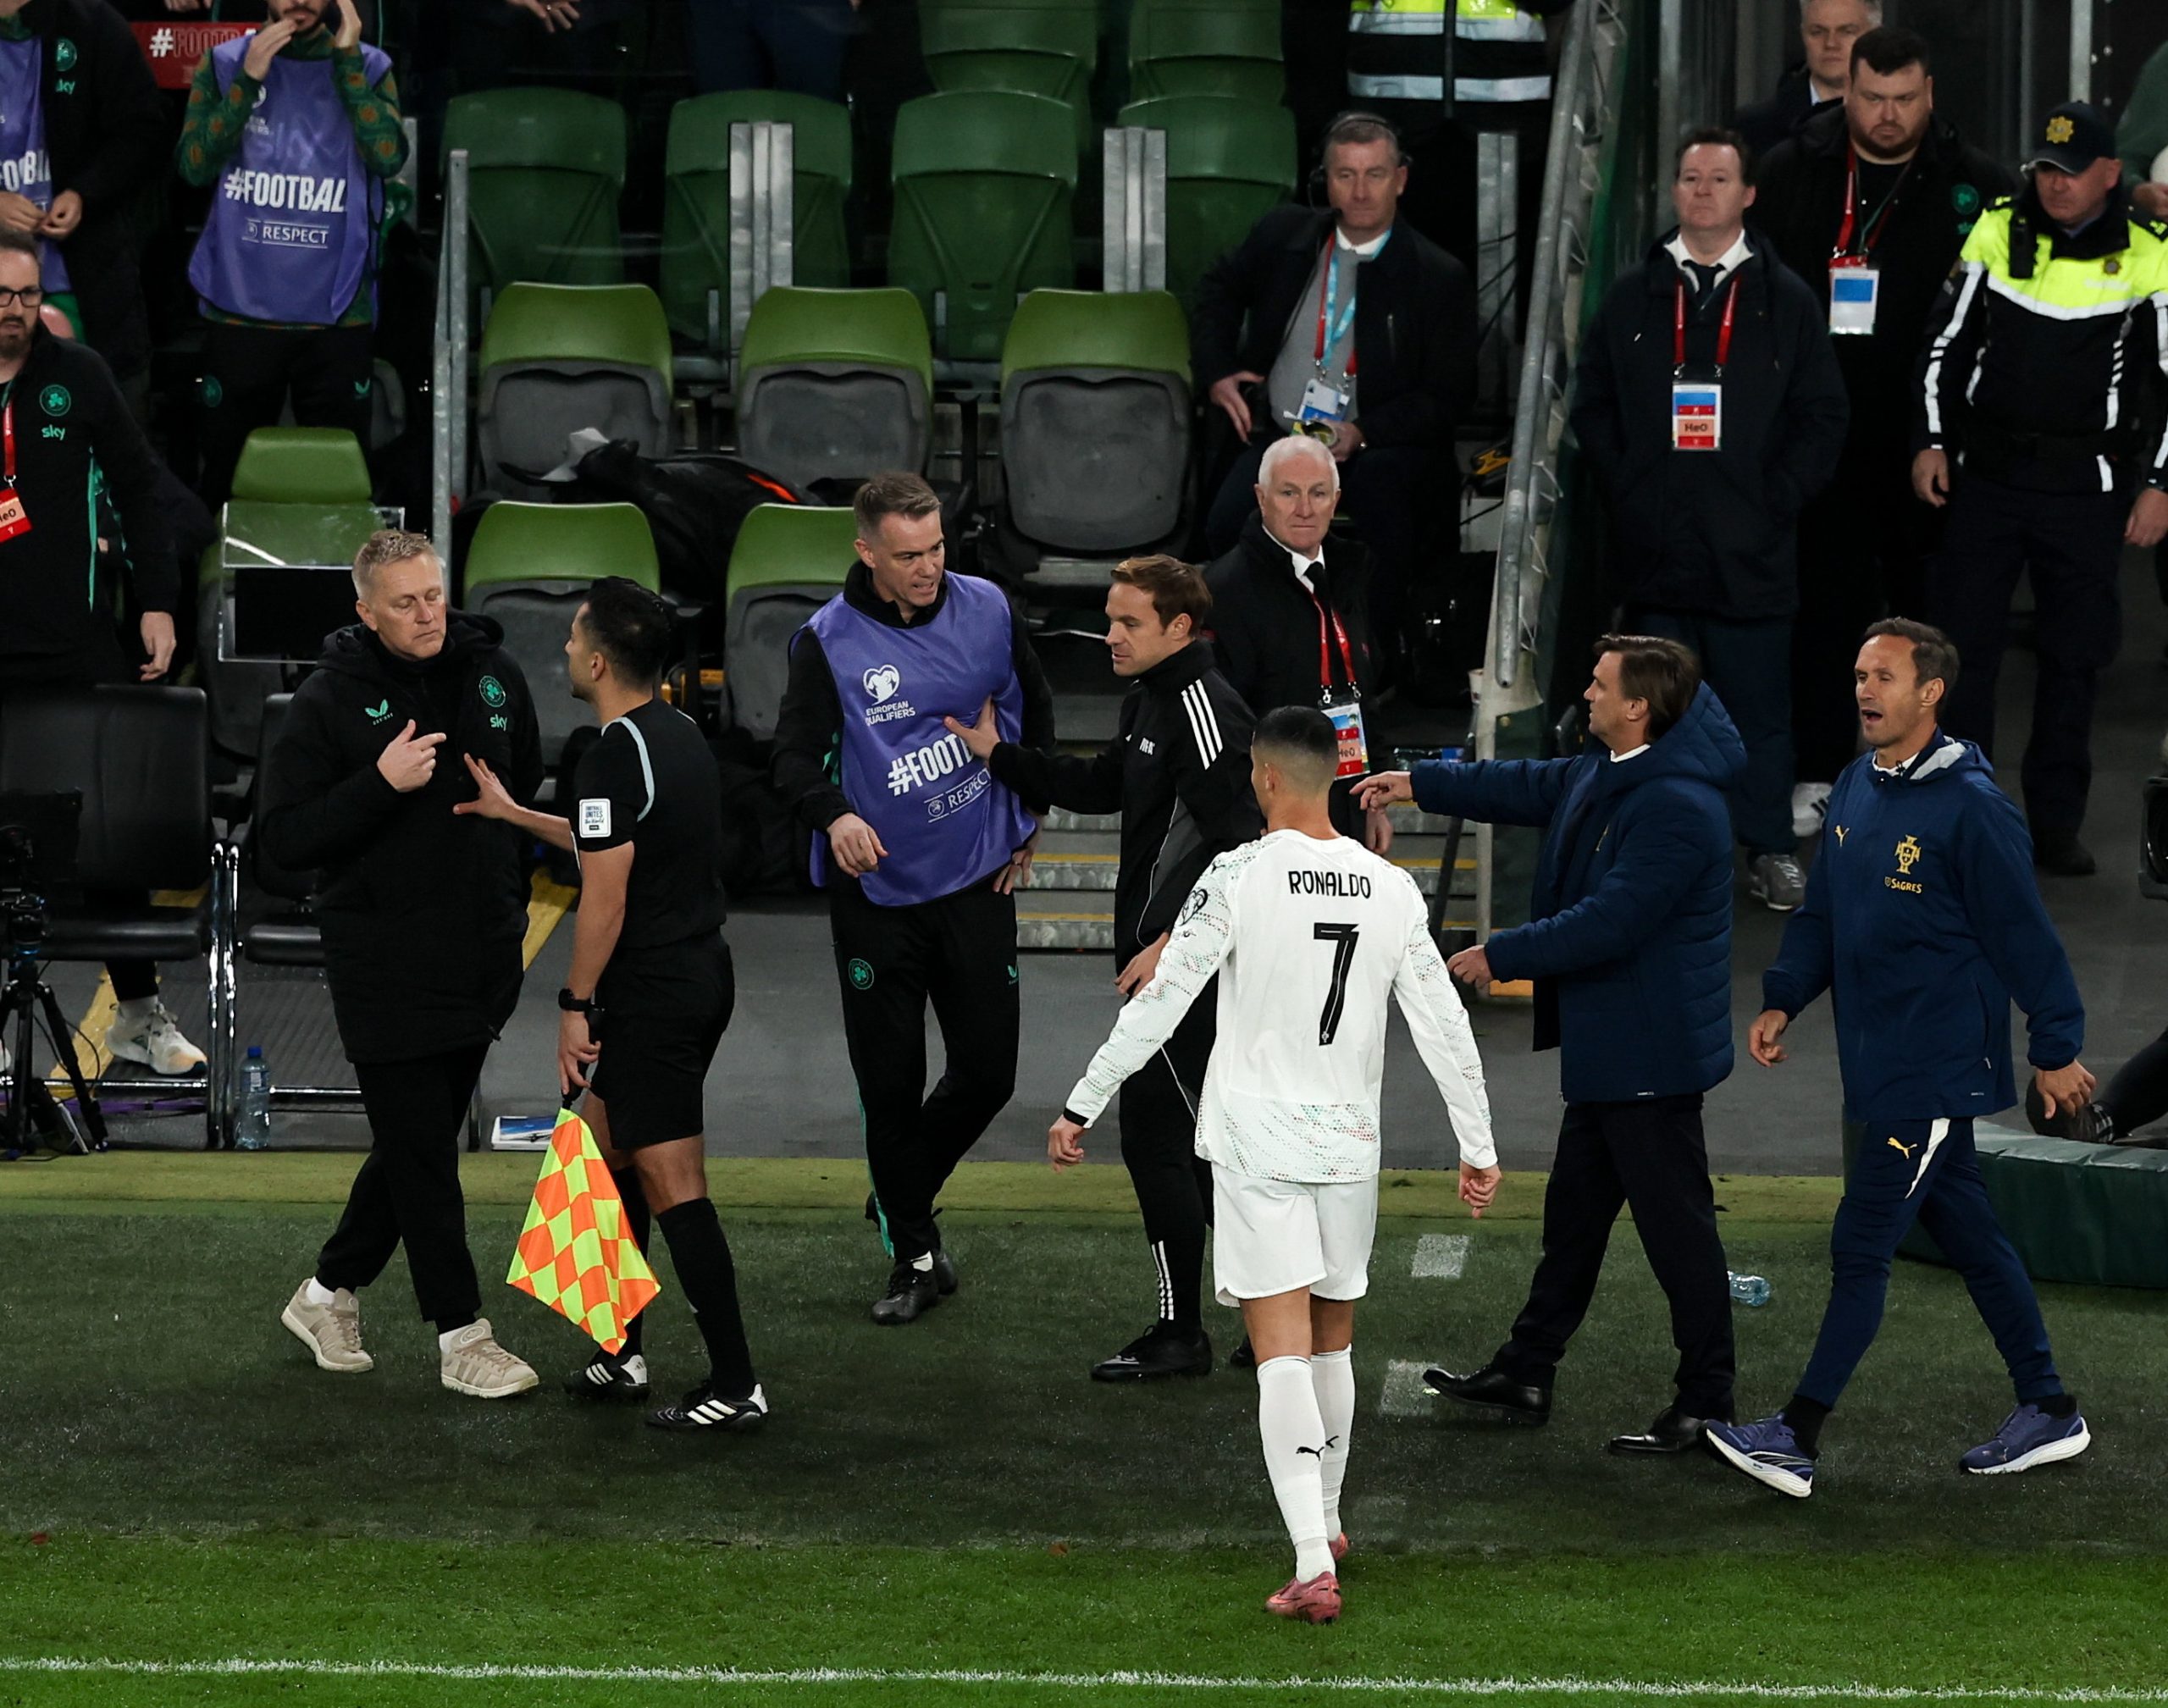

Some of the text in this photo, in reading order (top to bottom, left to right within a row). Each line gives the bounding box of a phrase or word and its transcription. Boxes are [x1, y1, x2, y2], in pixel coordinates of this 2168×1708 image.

[263, 225, 329, 244] RESPECT
[41, 424, 65, 440] sky
[866, 700, 909, 716] EUROPEAN
[489, 714, 507, 731] sky
[1288, 871, 1371, 898] RONALDO
[1314, 922, 1359, 1046] 7
